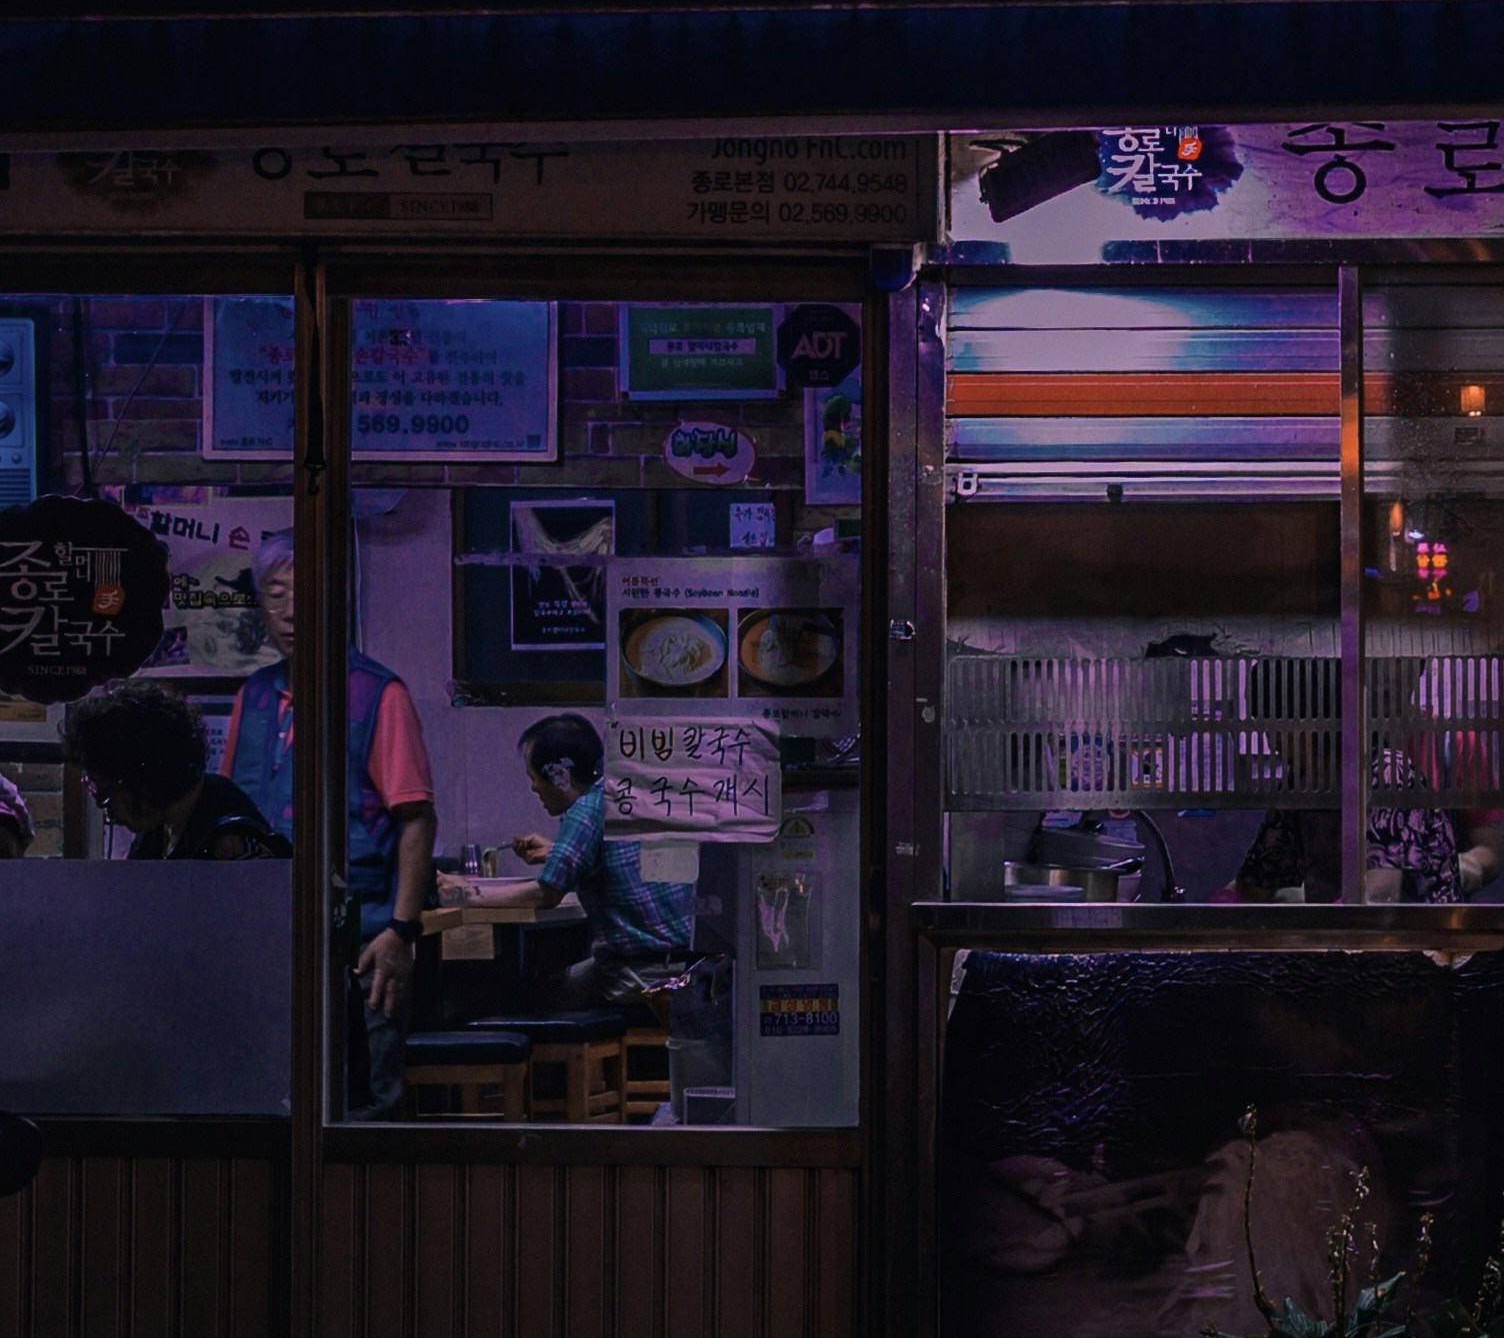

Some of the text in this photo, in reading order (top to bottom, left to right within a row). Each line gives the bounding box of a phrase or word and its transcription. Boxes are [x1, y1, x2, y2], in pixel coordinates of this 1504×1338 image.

[690, 170, 909, 194] 종로본점 02.744.9548
[1107, 154, 1203, 193] 칼국수
[686, 201, 908, 225] 가맹문의 02.569.9900
[790, 331, 848, 360] ADT
[357, 413, 471, 436] 569.9900
[151, 511, 220, 544] 할머니
[682, 725, 752, 766] 칼국수
[775, 1013, 838, 1025] 713-8100
